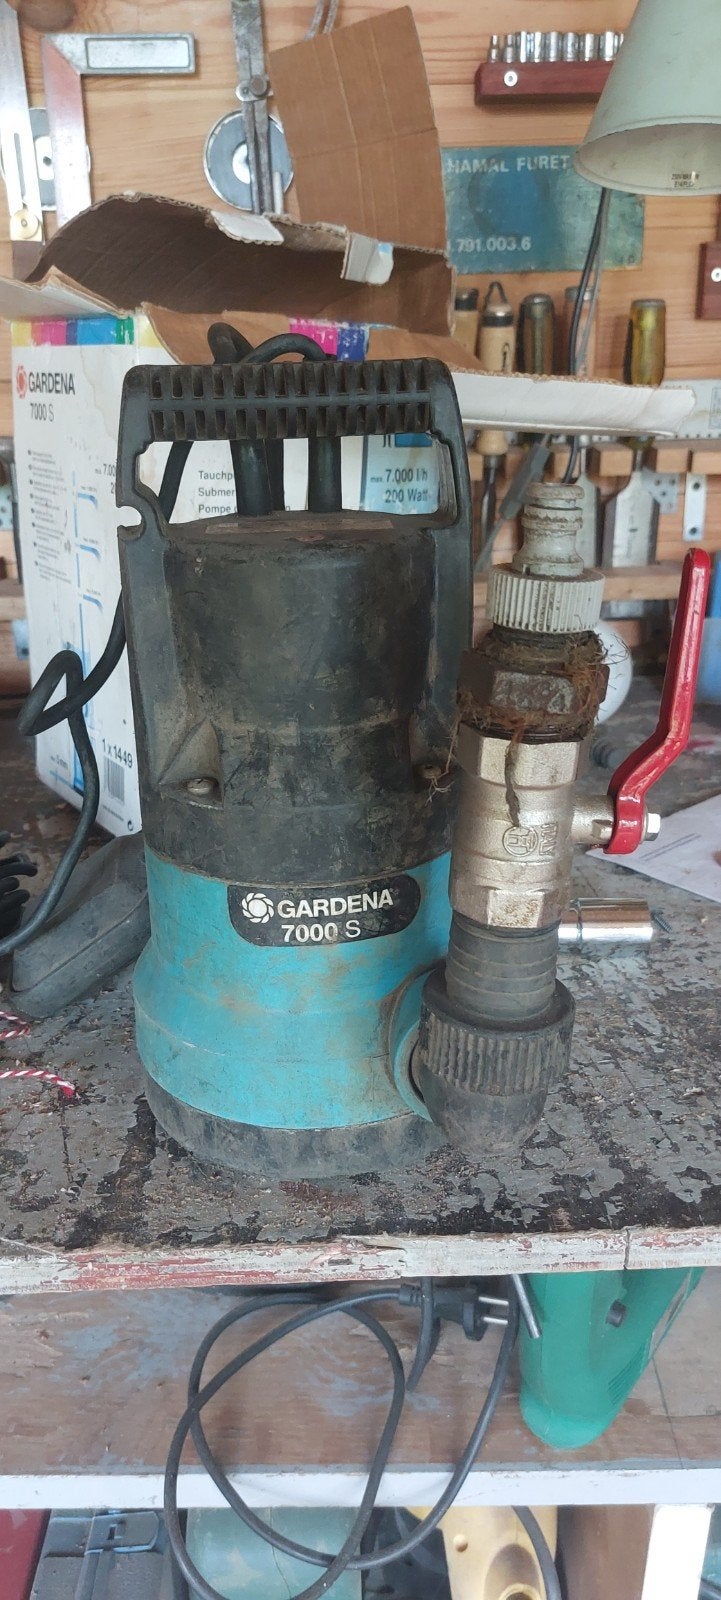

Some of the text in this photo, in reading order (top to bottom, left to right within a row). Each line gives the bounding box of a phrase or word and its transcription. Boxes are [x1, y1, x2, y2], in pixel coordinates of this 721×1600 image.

[516, 155, 570, 172] FURET
[28, 371, 76, 395] GARDENA
[30, 402, 55, 422] 7000 S
[385, 468, 413, 483] 7.000
[385, 489, 404, 503] 200
[198, 504, 232, 514] Pompe
[113, 745, 133, 768] 1449
[277, 888, 394, 919] GARDENA
[281, 920, 361, 943] 7000 S
